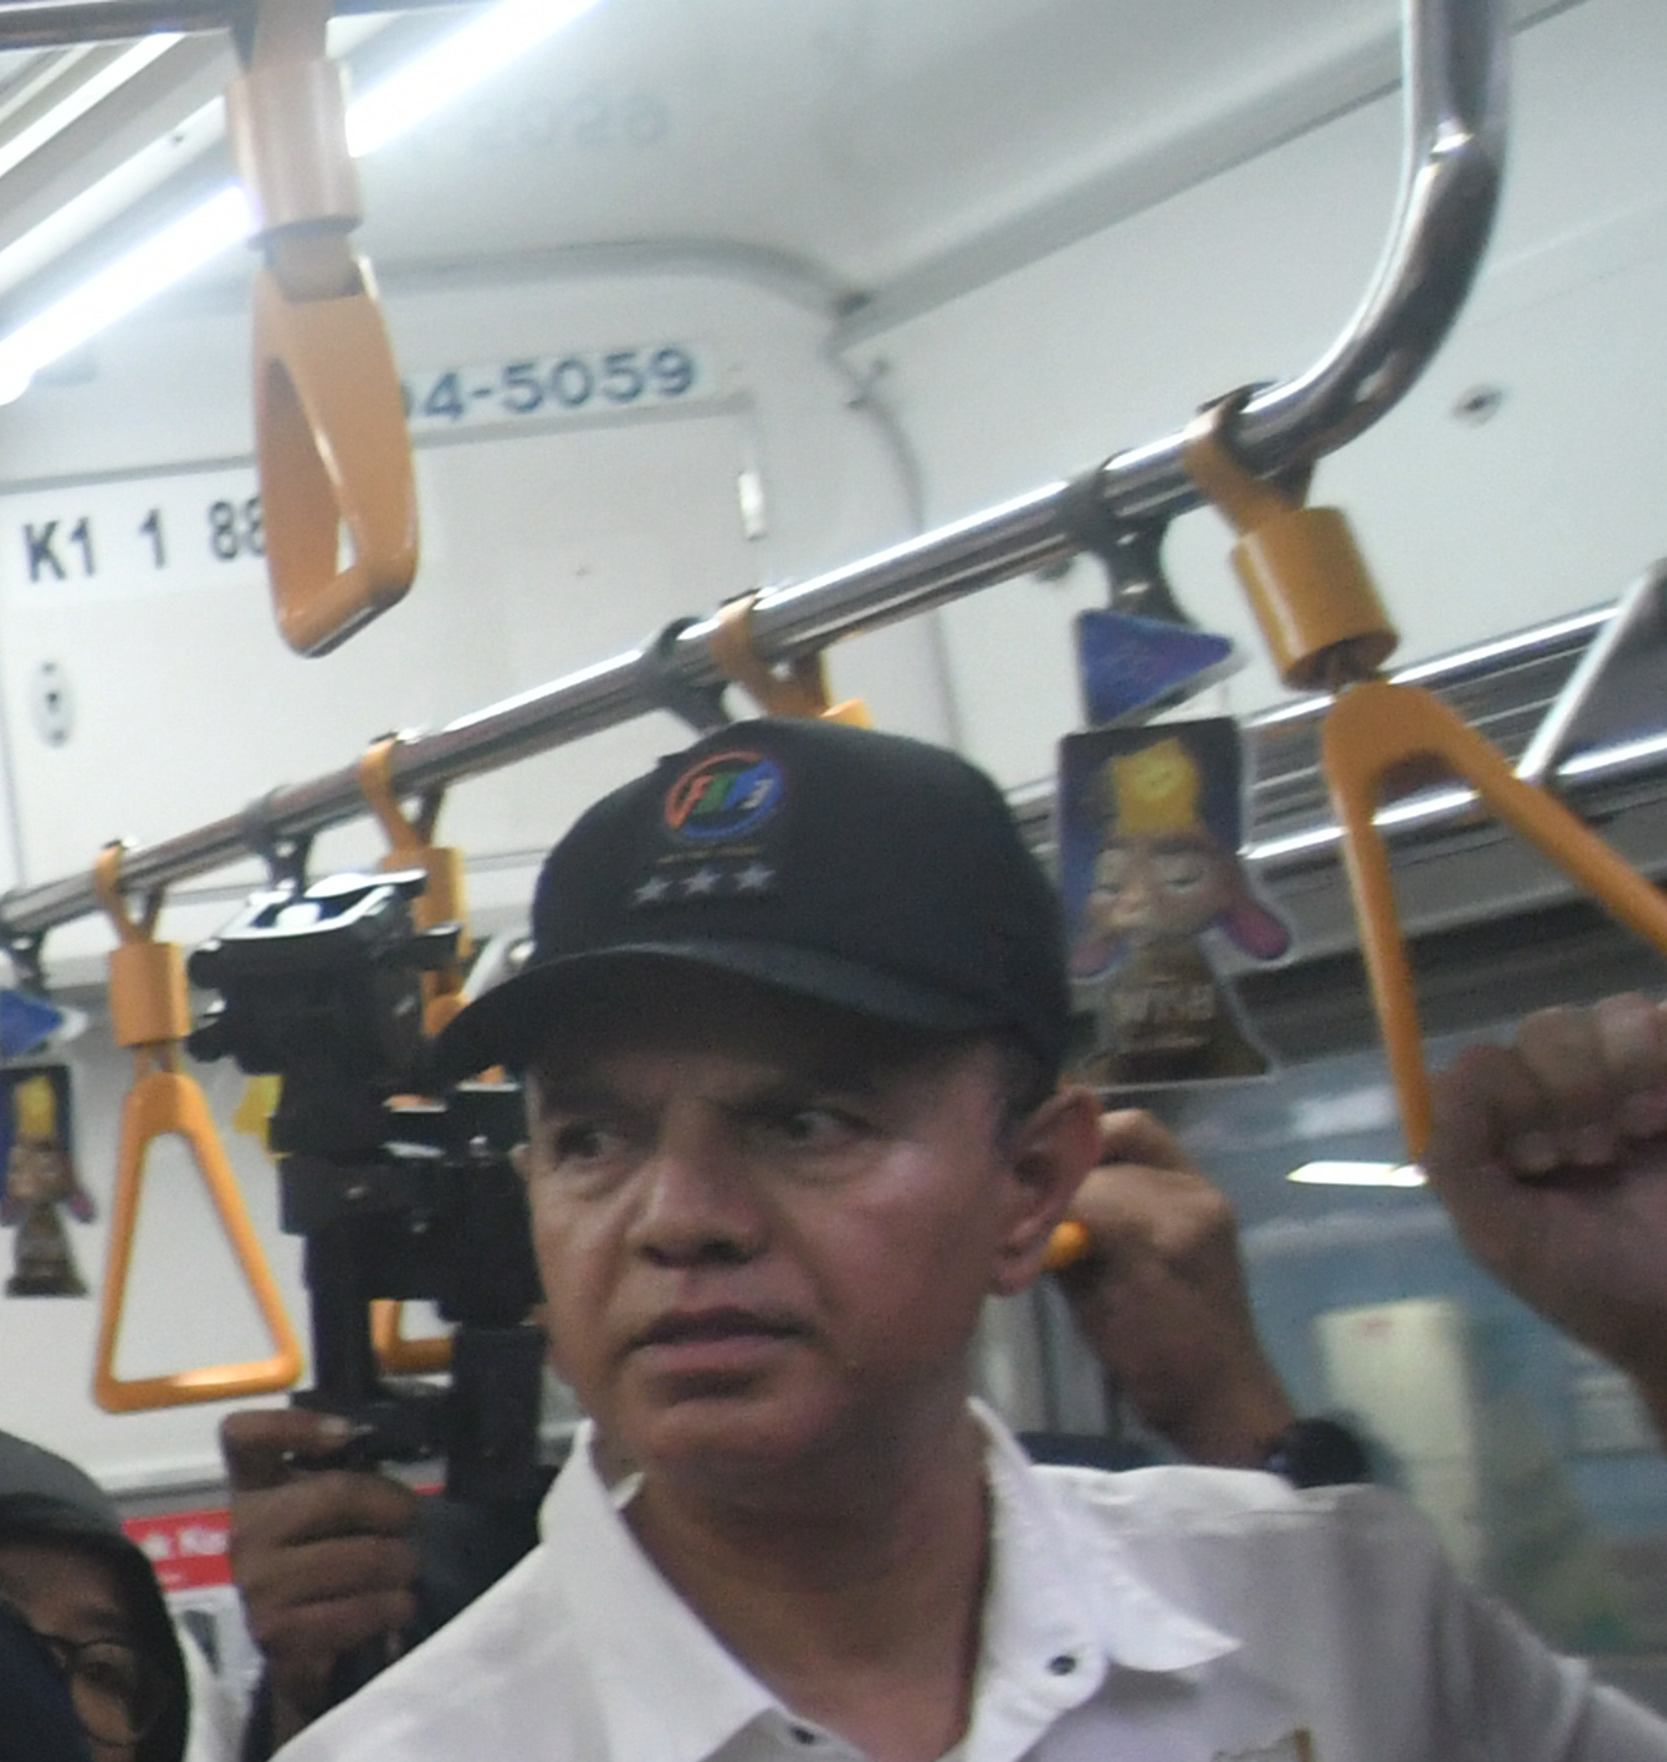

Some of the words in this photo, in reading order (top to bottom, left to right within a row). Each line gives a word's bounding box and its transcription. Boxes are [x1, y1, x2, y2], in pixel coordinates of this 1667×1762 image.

[400, 347, 695, 420] 4-5059
[23, 517, 95, 583] K1
[139, 508, 166, 569] 1
